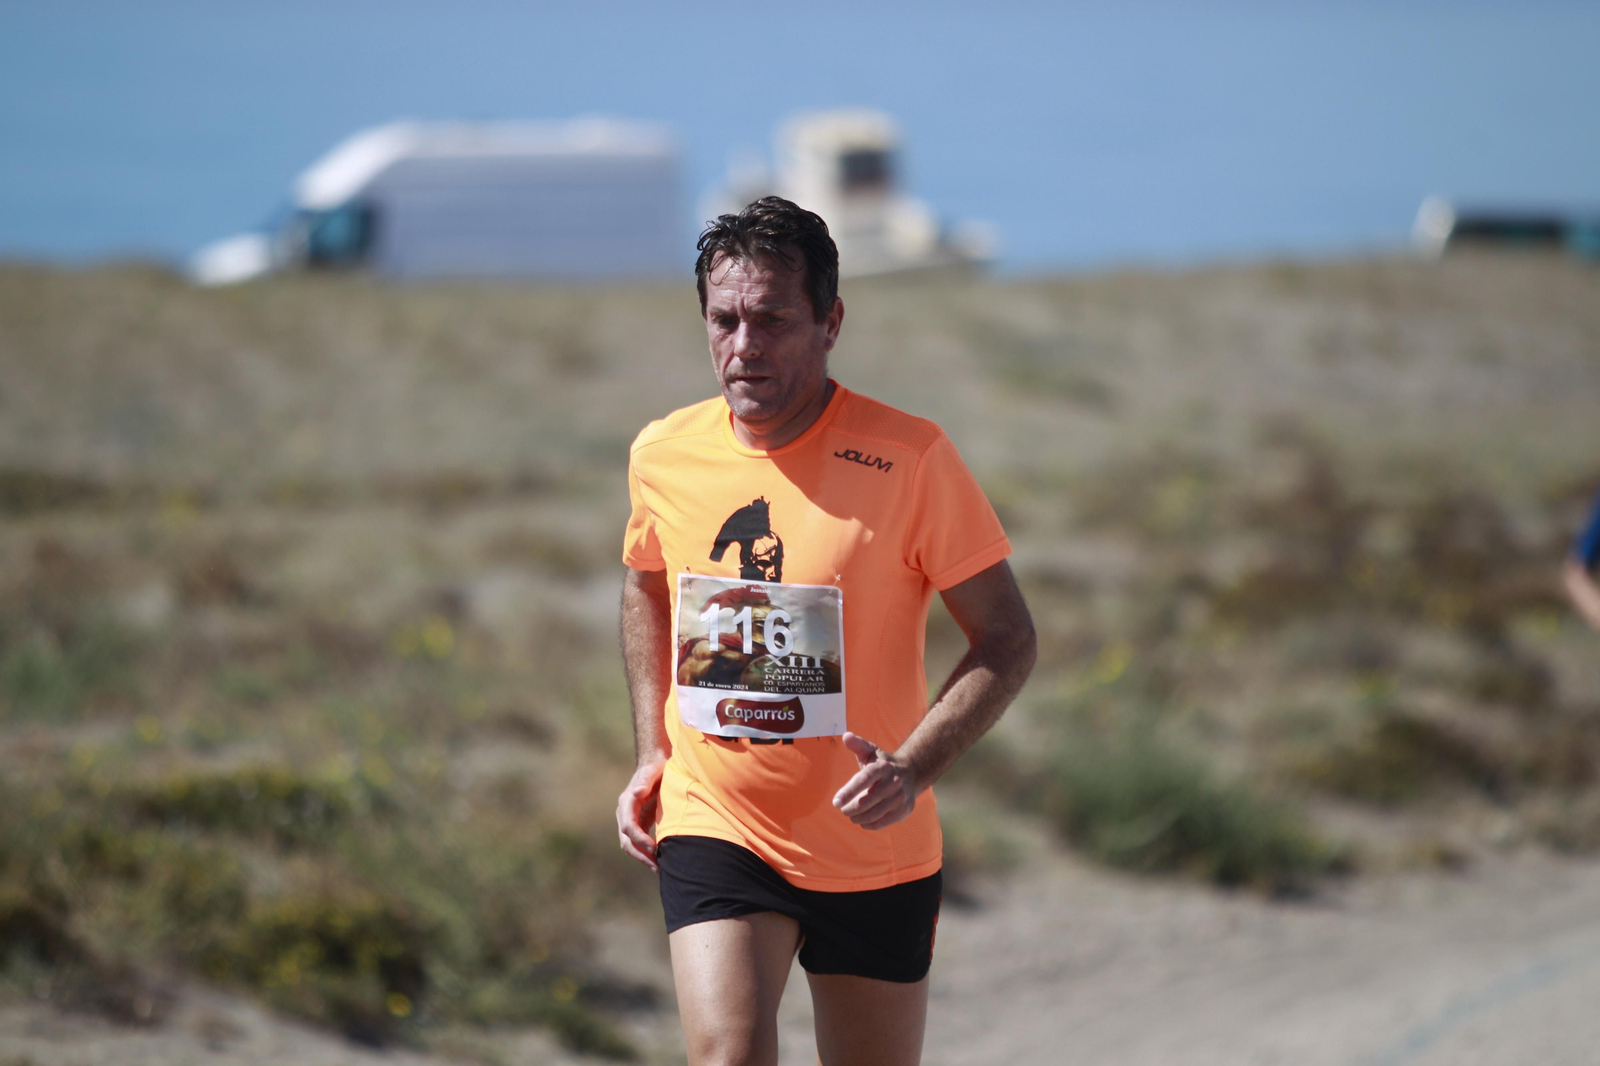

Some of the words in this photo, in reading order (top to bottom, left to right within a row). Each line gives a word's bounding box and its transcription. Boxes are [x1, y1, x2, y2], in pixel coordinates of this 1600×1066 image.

[833, 448, 894, 473] JOLUVI
[700, 603, 795, 656] 116
[765, 654, 824, 669] XIII
[765, 667, 825, 675] CARRERA
[765, 674, 824, 682] POPULAR
